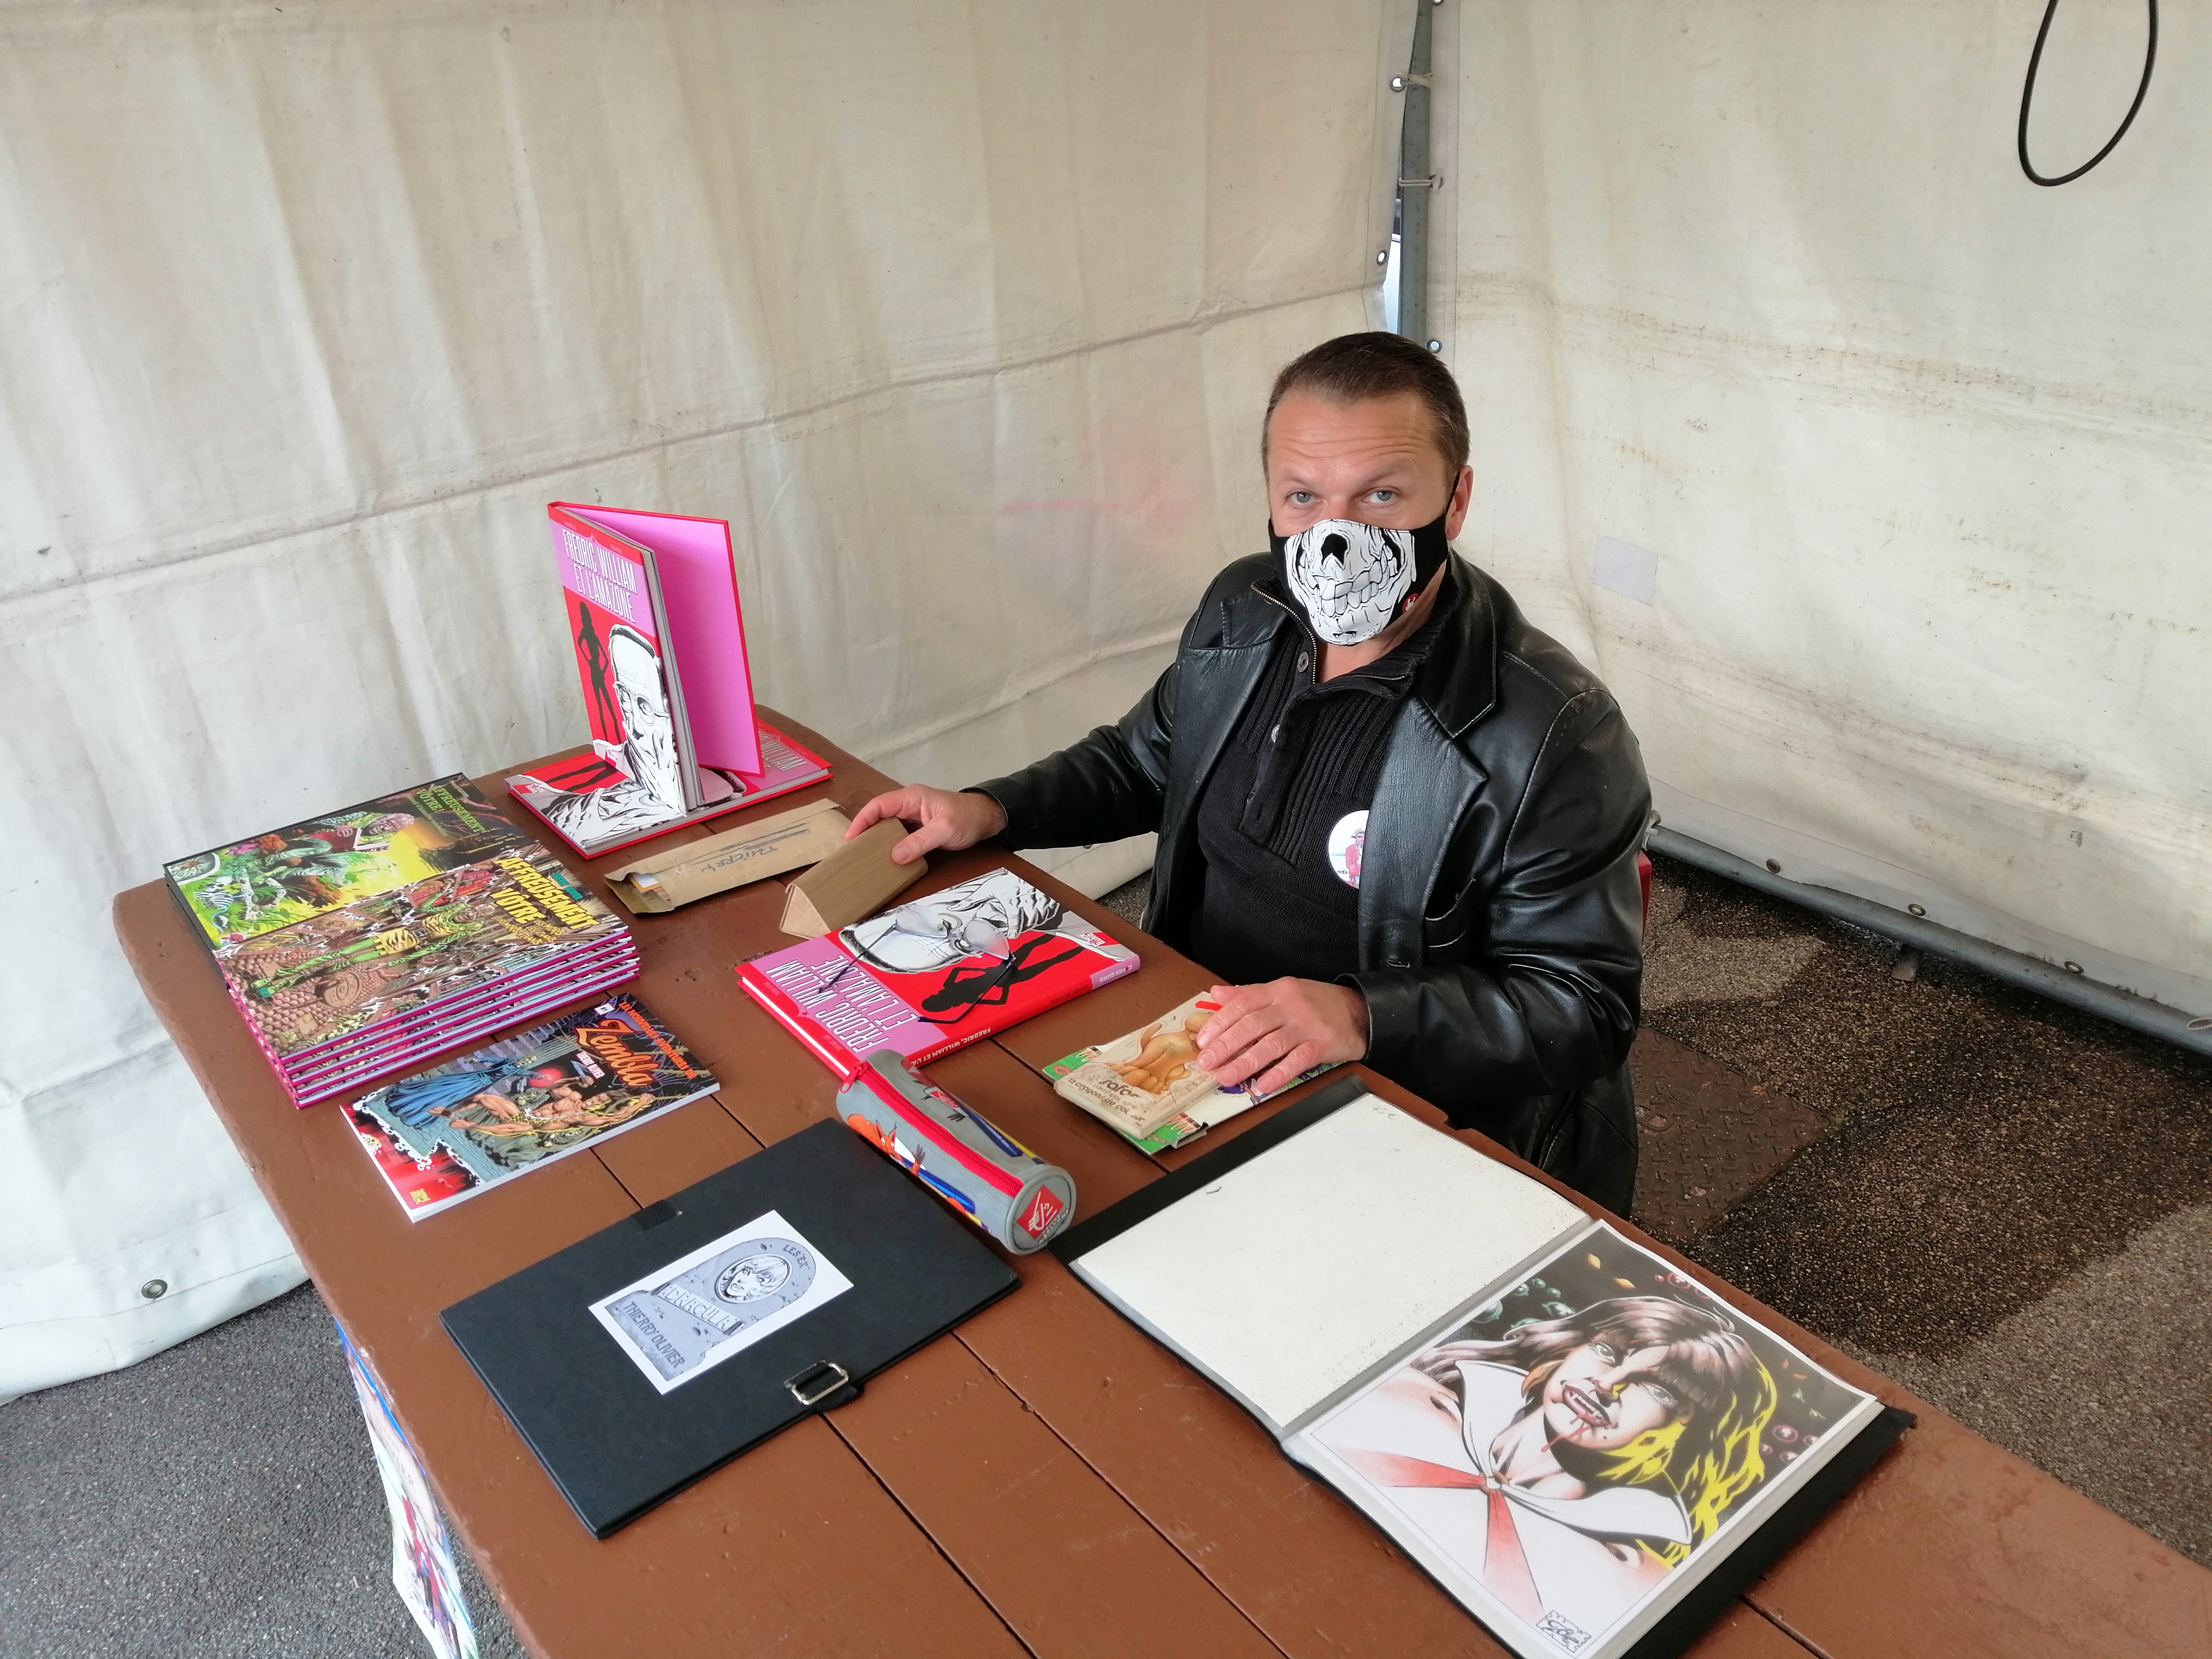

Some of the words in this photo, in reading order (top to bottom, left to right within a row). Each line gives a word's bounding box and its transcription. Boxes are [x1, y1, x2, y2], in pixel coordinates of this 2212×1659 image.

[562, 528, 601, 576] FREDRIC,
[596, 546, 637, 595] WILLIAM
[573, 563, 586, 595] ET
[585, 569, 635, 623] L'AMAZONE
[432, 785, 486, 833] AFFREUSEMENT
[493, 857, 601, 929] AFFREUSEMENT
[766, 960, 838, 1009] WILLIAM
[815, 998, 890, 1053] FREDRIC,
[874, 1008, 919, 1031] ET
[961, 1027, 992, 1044] FREDRIC,
[575, 1018, 660, 1087] Zembla
[654, 1037, 690, 1070] AVENTURES
[923, 1053, 931, 1062] ET
[932, 1040, 960, 1057] WILLIAM
[1075, 1082, 1106, 1099] crayons
[783, 1244, 801, 1257] LES
[664, 1287, 731, 1330] DRACULA
[623, 1301, 659, 1336] THIERRY
[651, 1334, 685, 1368] OLIVIER
